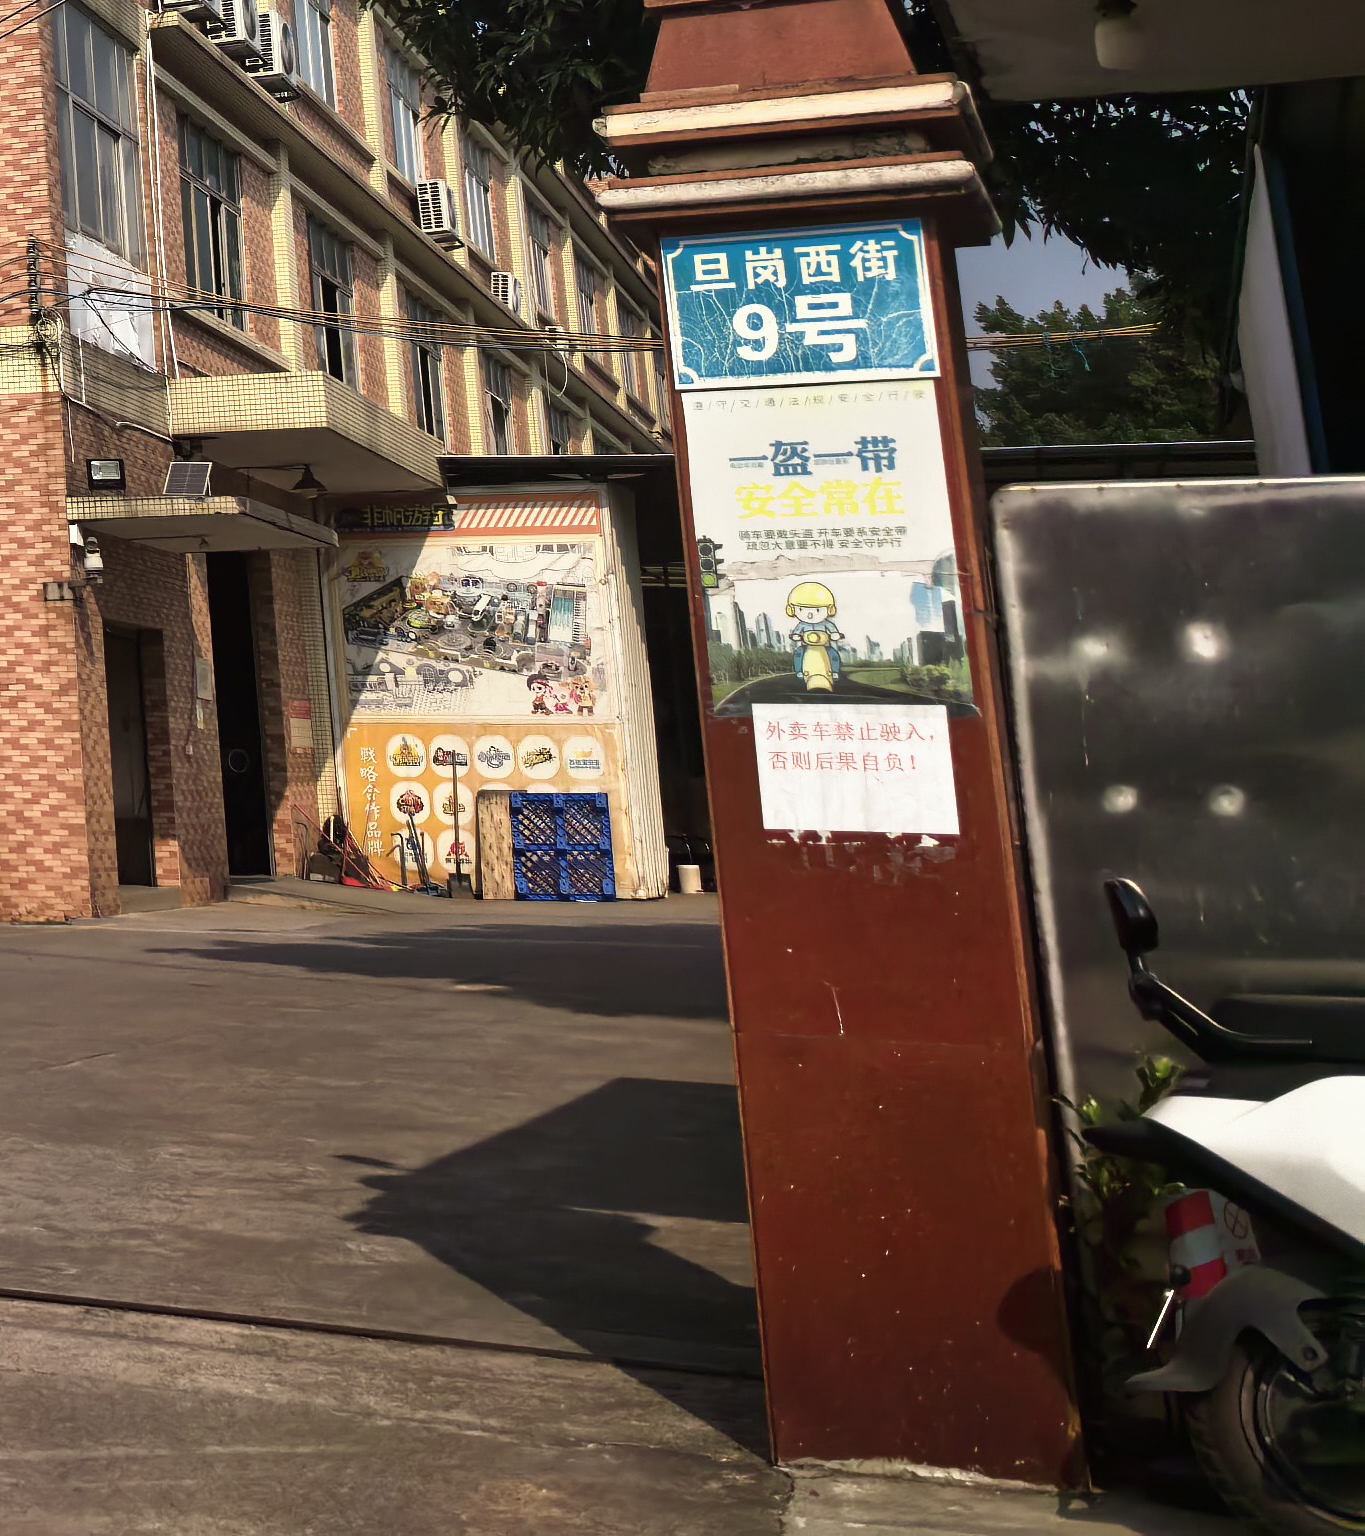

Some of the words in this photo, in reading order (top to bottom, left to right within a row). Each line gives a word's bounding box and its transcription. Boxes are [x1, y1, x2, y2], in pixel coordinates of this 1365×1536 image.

[690, 240, 899, 291] 旦岗西街
[732, 292, 869, 363] 9号
[729, 436, 897, 477] 一盔一带
[734, 476, 906, 520] 安全常在
[768, 750, 917, 772] 否则后果自负！
